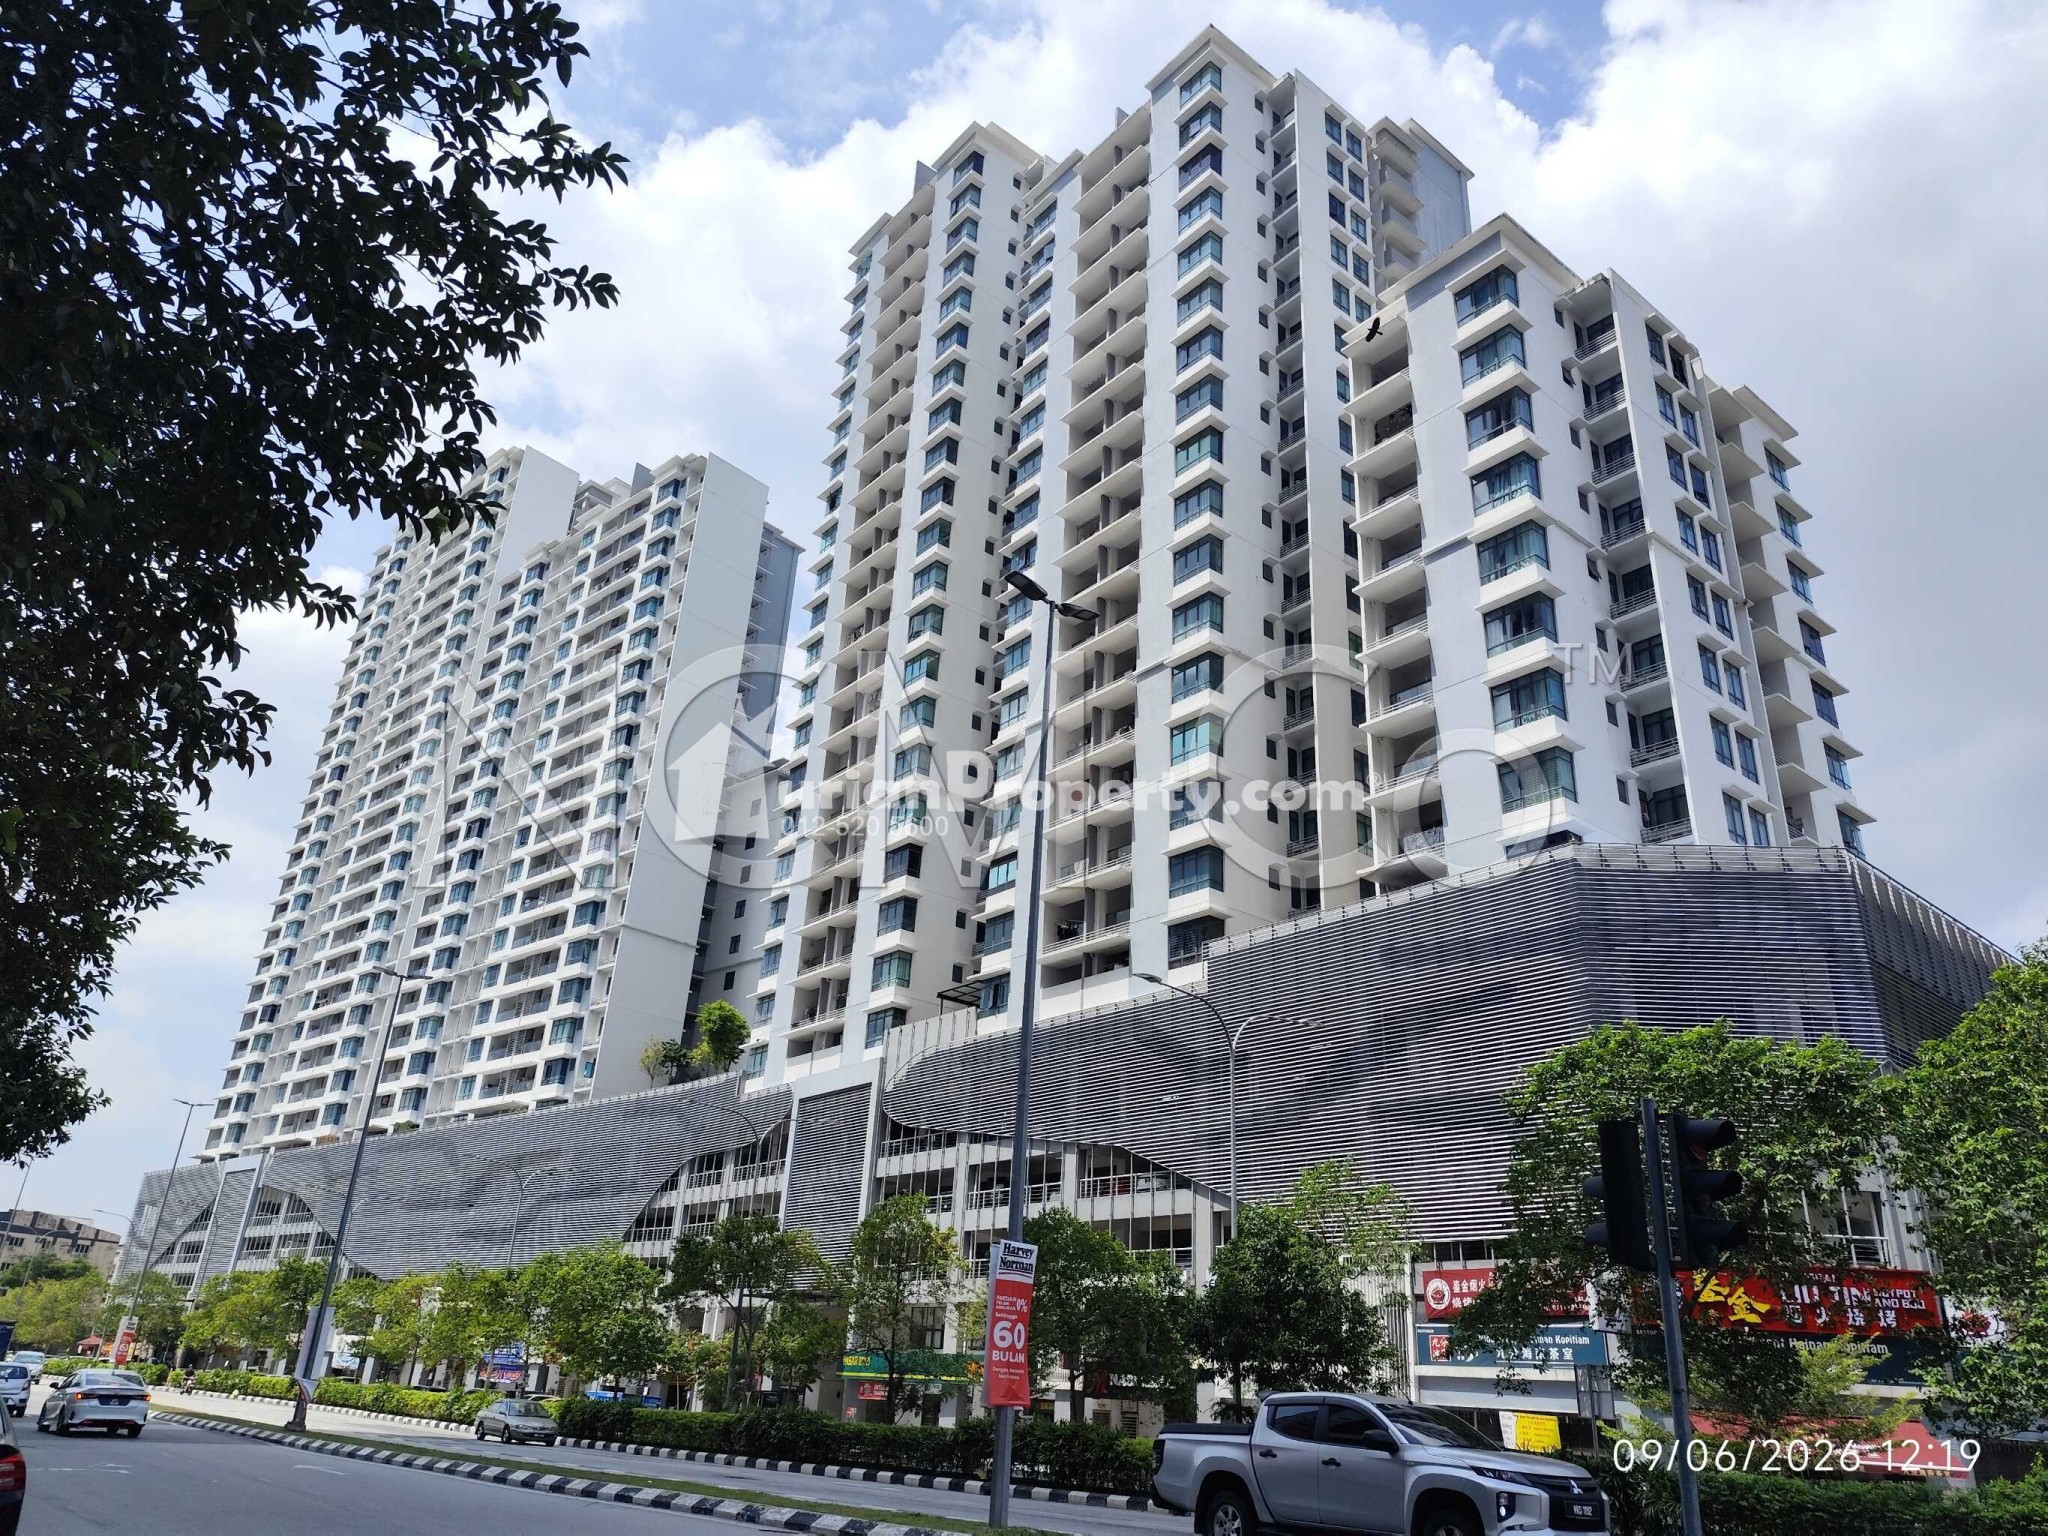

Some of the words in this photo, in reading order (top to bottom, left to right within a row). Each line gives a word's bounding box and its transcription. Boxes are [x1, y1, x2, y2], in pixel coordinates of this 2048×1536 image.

[1003, 1243, 1034, 1260] Harvey
[999, 1256, 1033, 1272] Norman
[993, 1320, 1026, 1350] 60
[1555, 1334, 1590, 1345] Kopitiam
[992, 1350, 1025, 1363] BULAN
